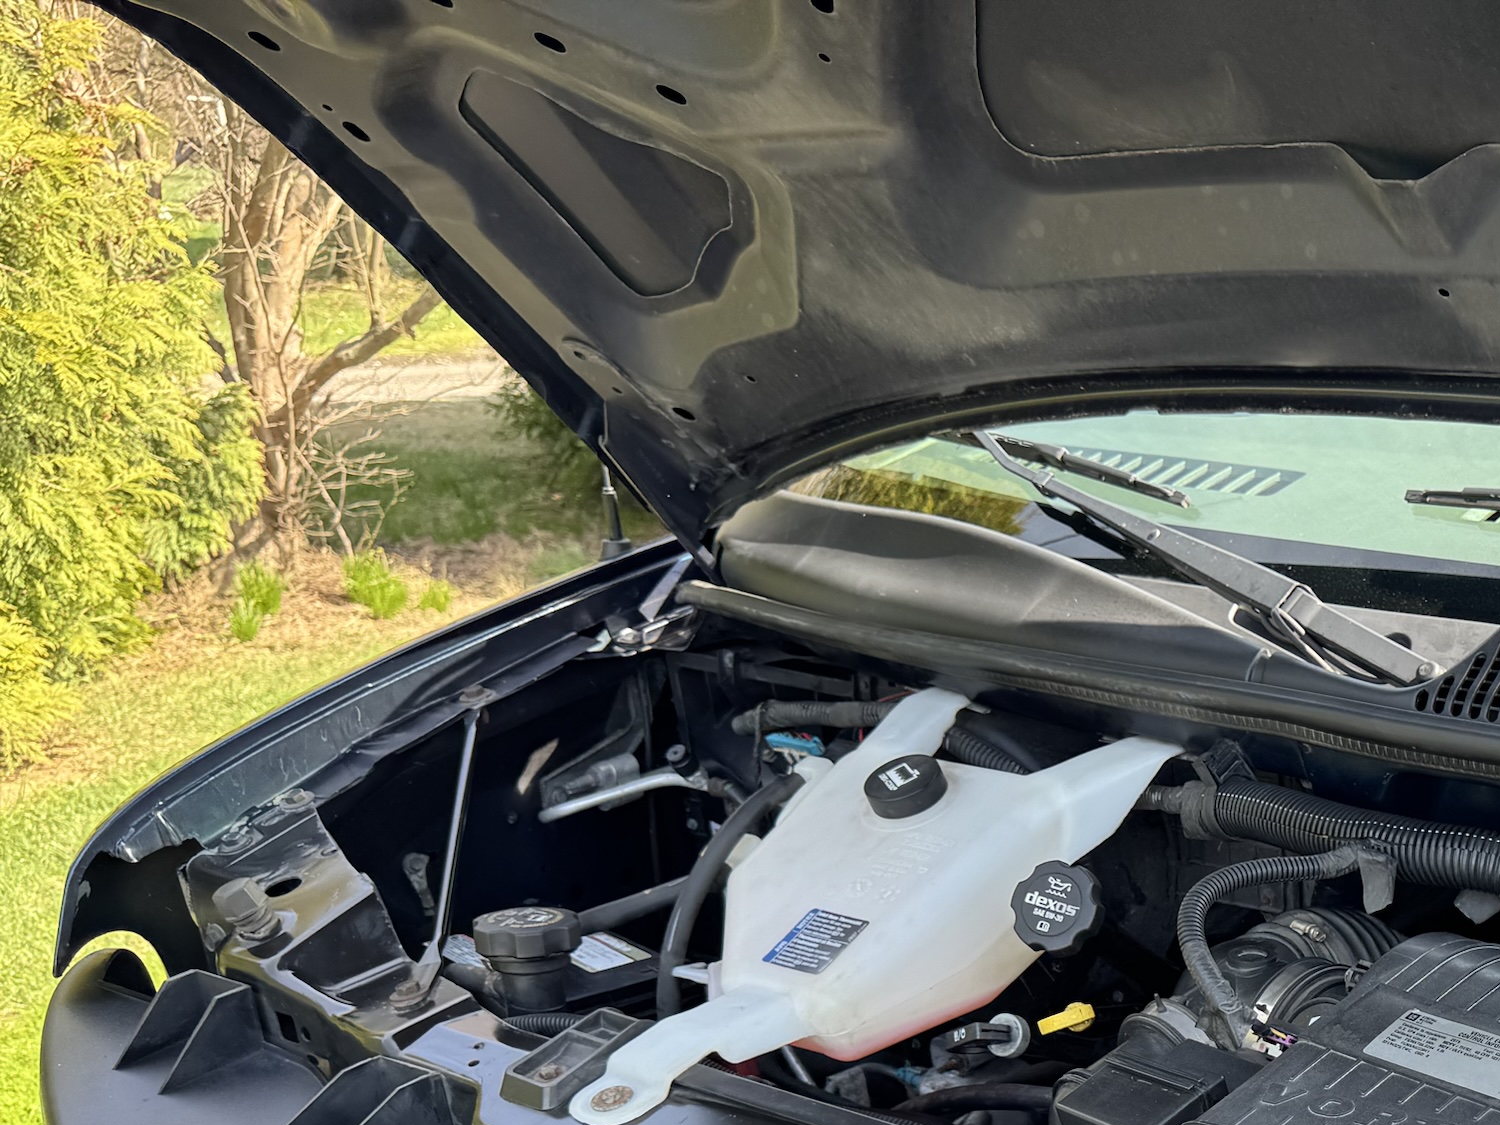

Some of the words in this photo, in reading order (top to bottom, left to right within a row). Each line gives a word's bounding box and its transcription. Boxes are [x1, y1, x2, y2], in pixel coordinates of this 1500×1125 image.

[1024, 891, 1080, 916] dexos
[1457, 1032, 1484, 1043] CONTROL
[1470, 1030, 1495, 1041] VEHICLE
